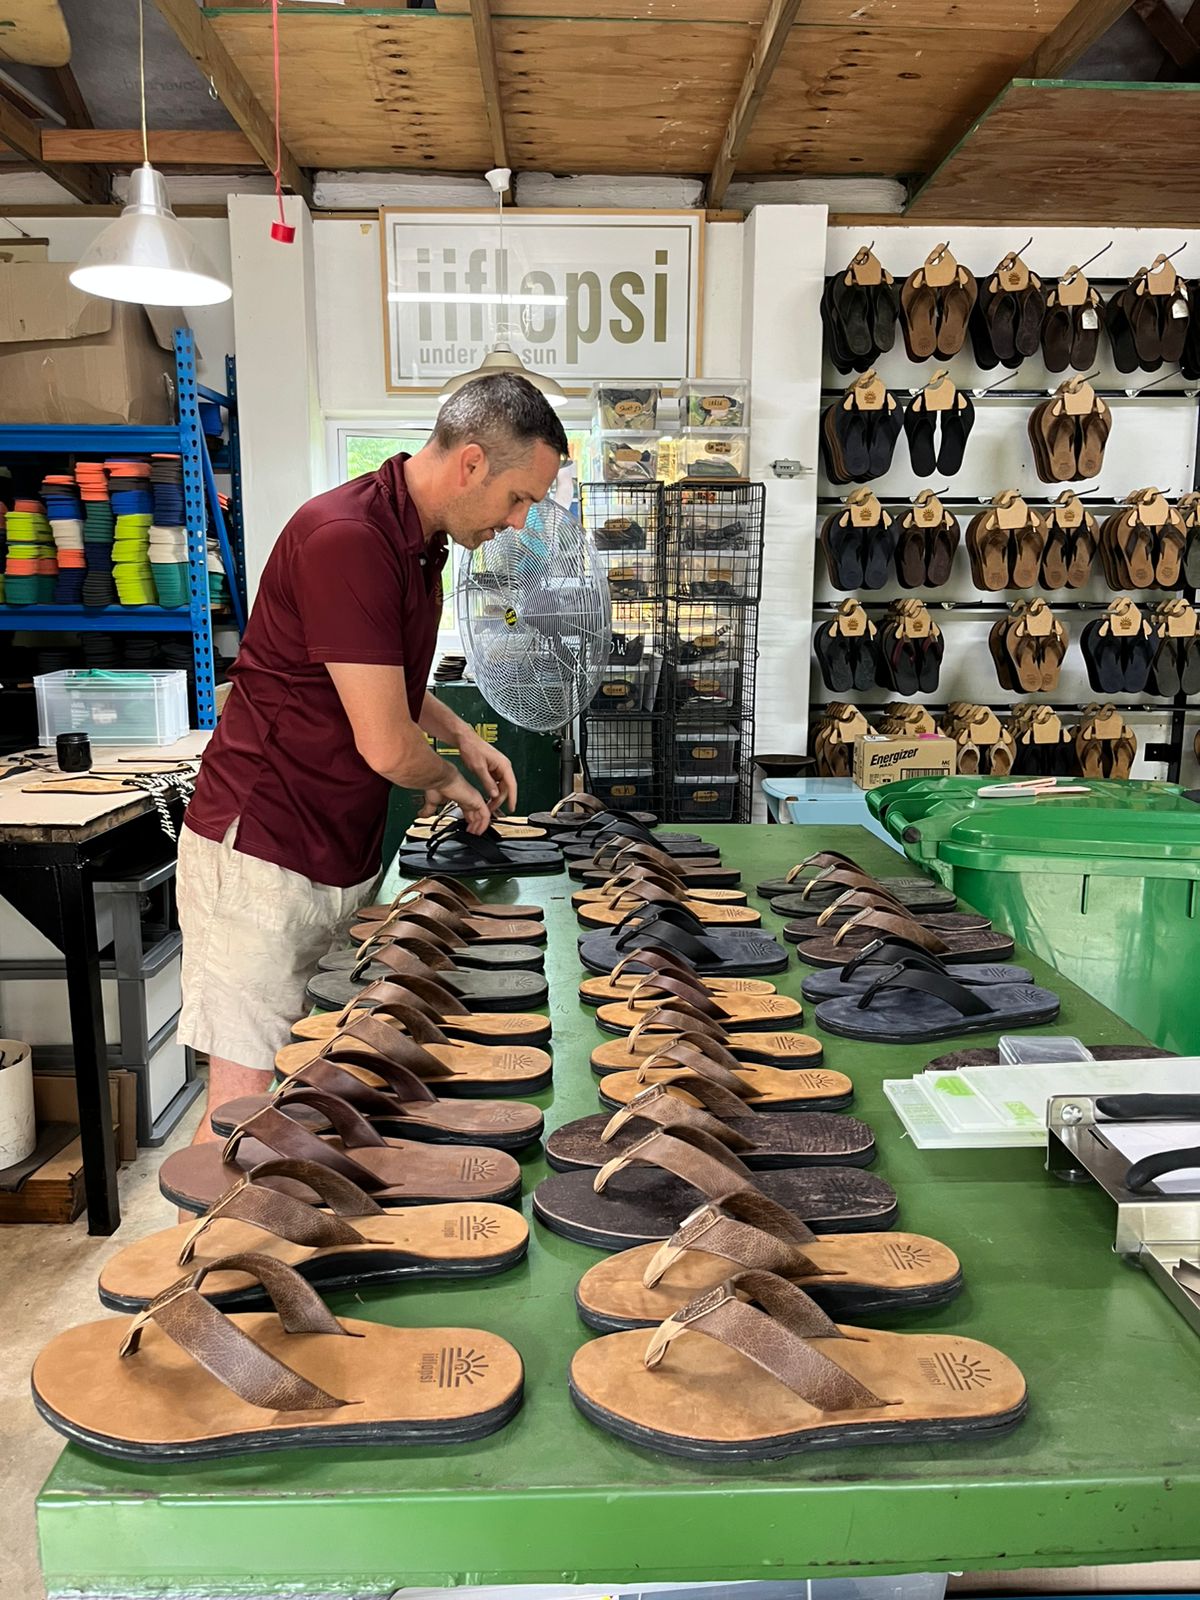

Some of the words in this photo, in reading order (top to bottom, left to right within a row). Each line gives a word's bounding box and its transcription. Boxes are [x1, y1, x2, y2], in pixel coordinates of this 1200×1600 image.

[416, 248, 669, 364] iiflopsi
[419, 344, 478, 364] under
[522, 347, 557, 365] sun
[870, 747, 919, 767] Energizer
